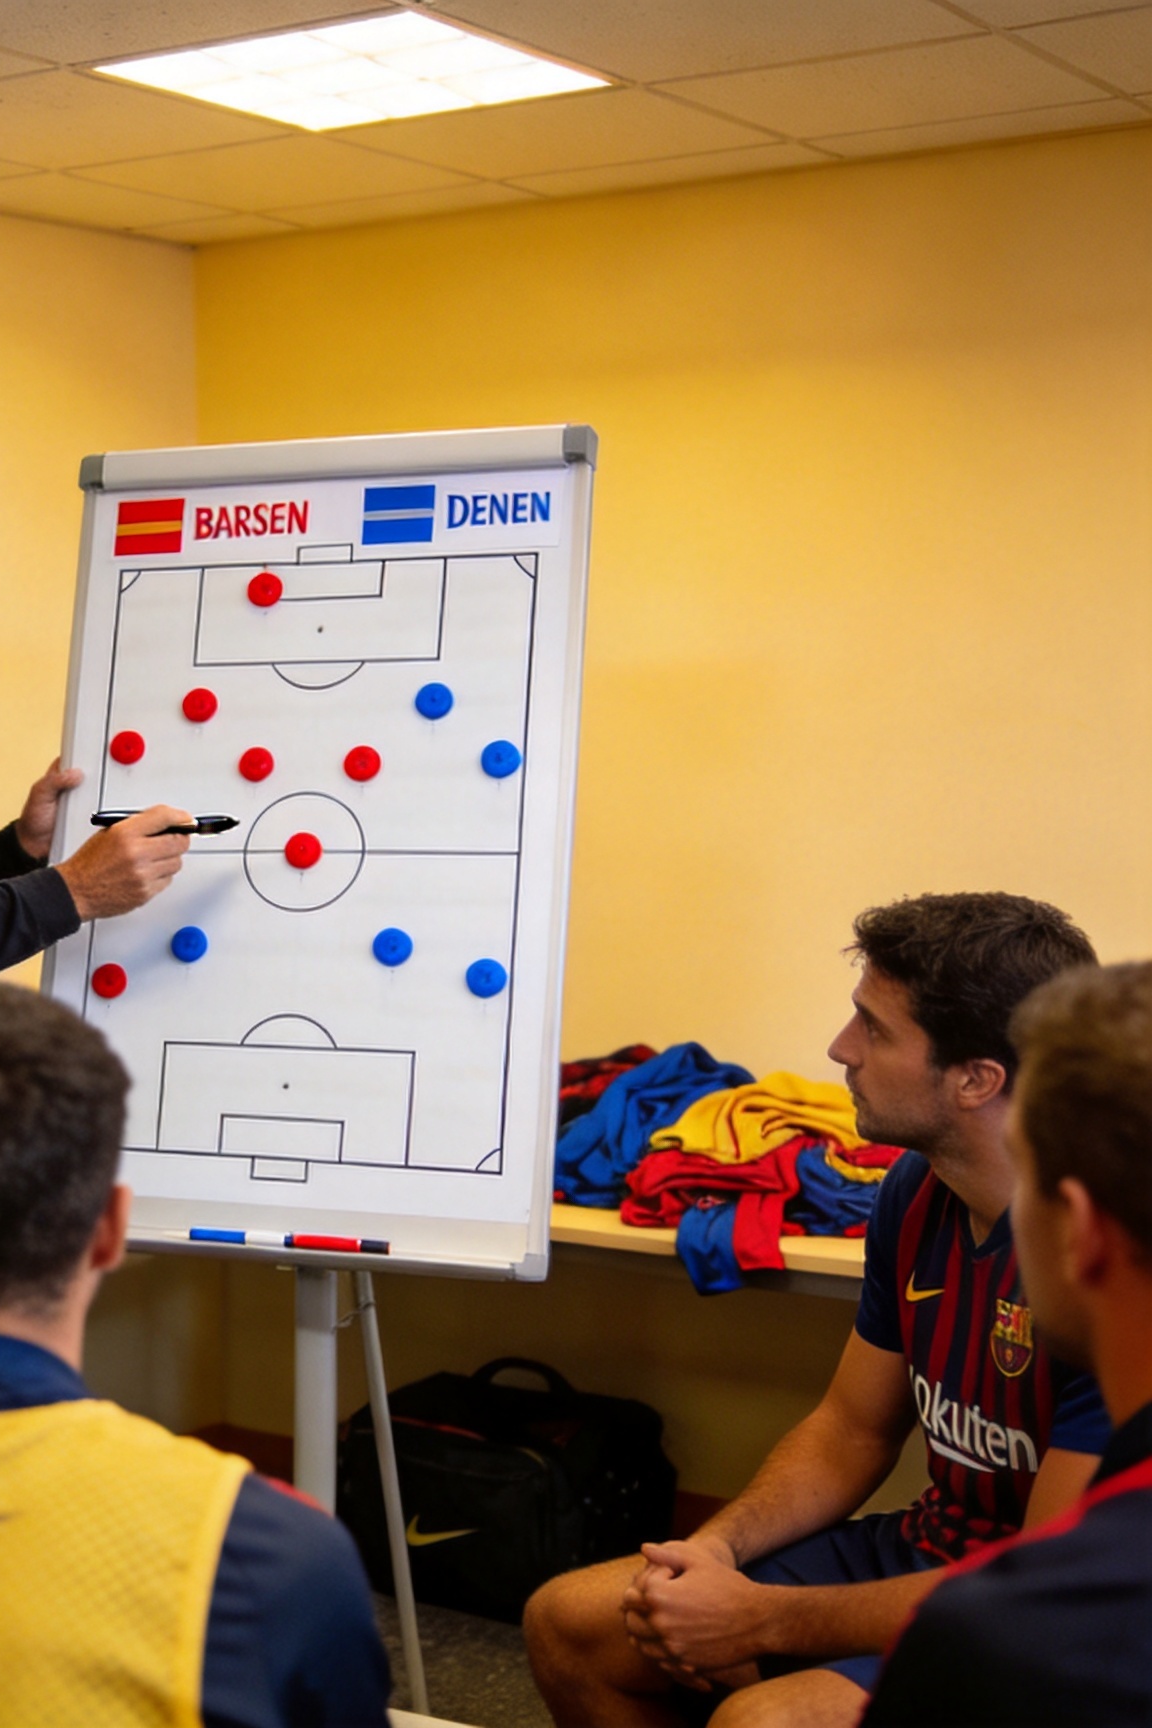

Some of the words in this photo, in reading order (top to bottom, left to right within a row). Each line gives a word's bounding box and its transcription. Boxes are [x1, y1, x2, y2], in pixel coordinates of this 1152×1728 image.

[194, 500, 308, 540] BARSEN
[447, 491, 550, 529] DENEN
[909, 1364, 1038, 1473] akuten
